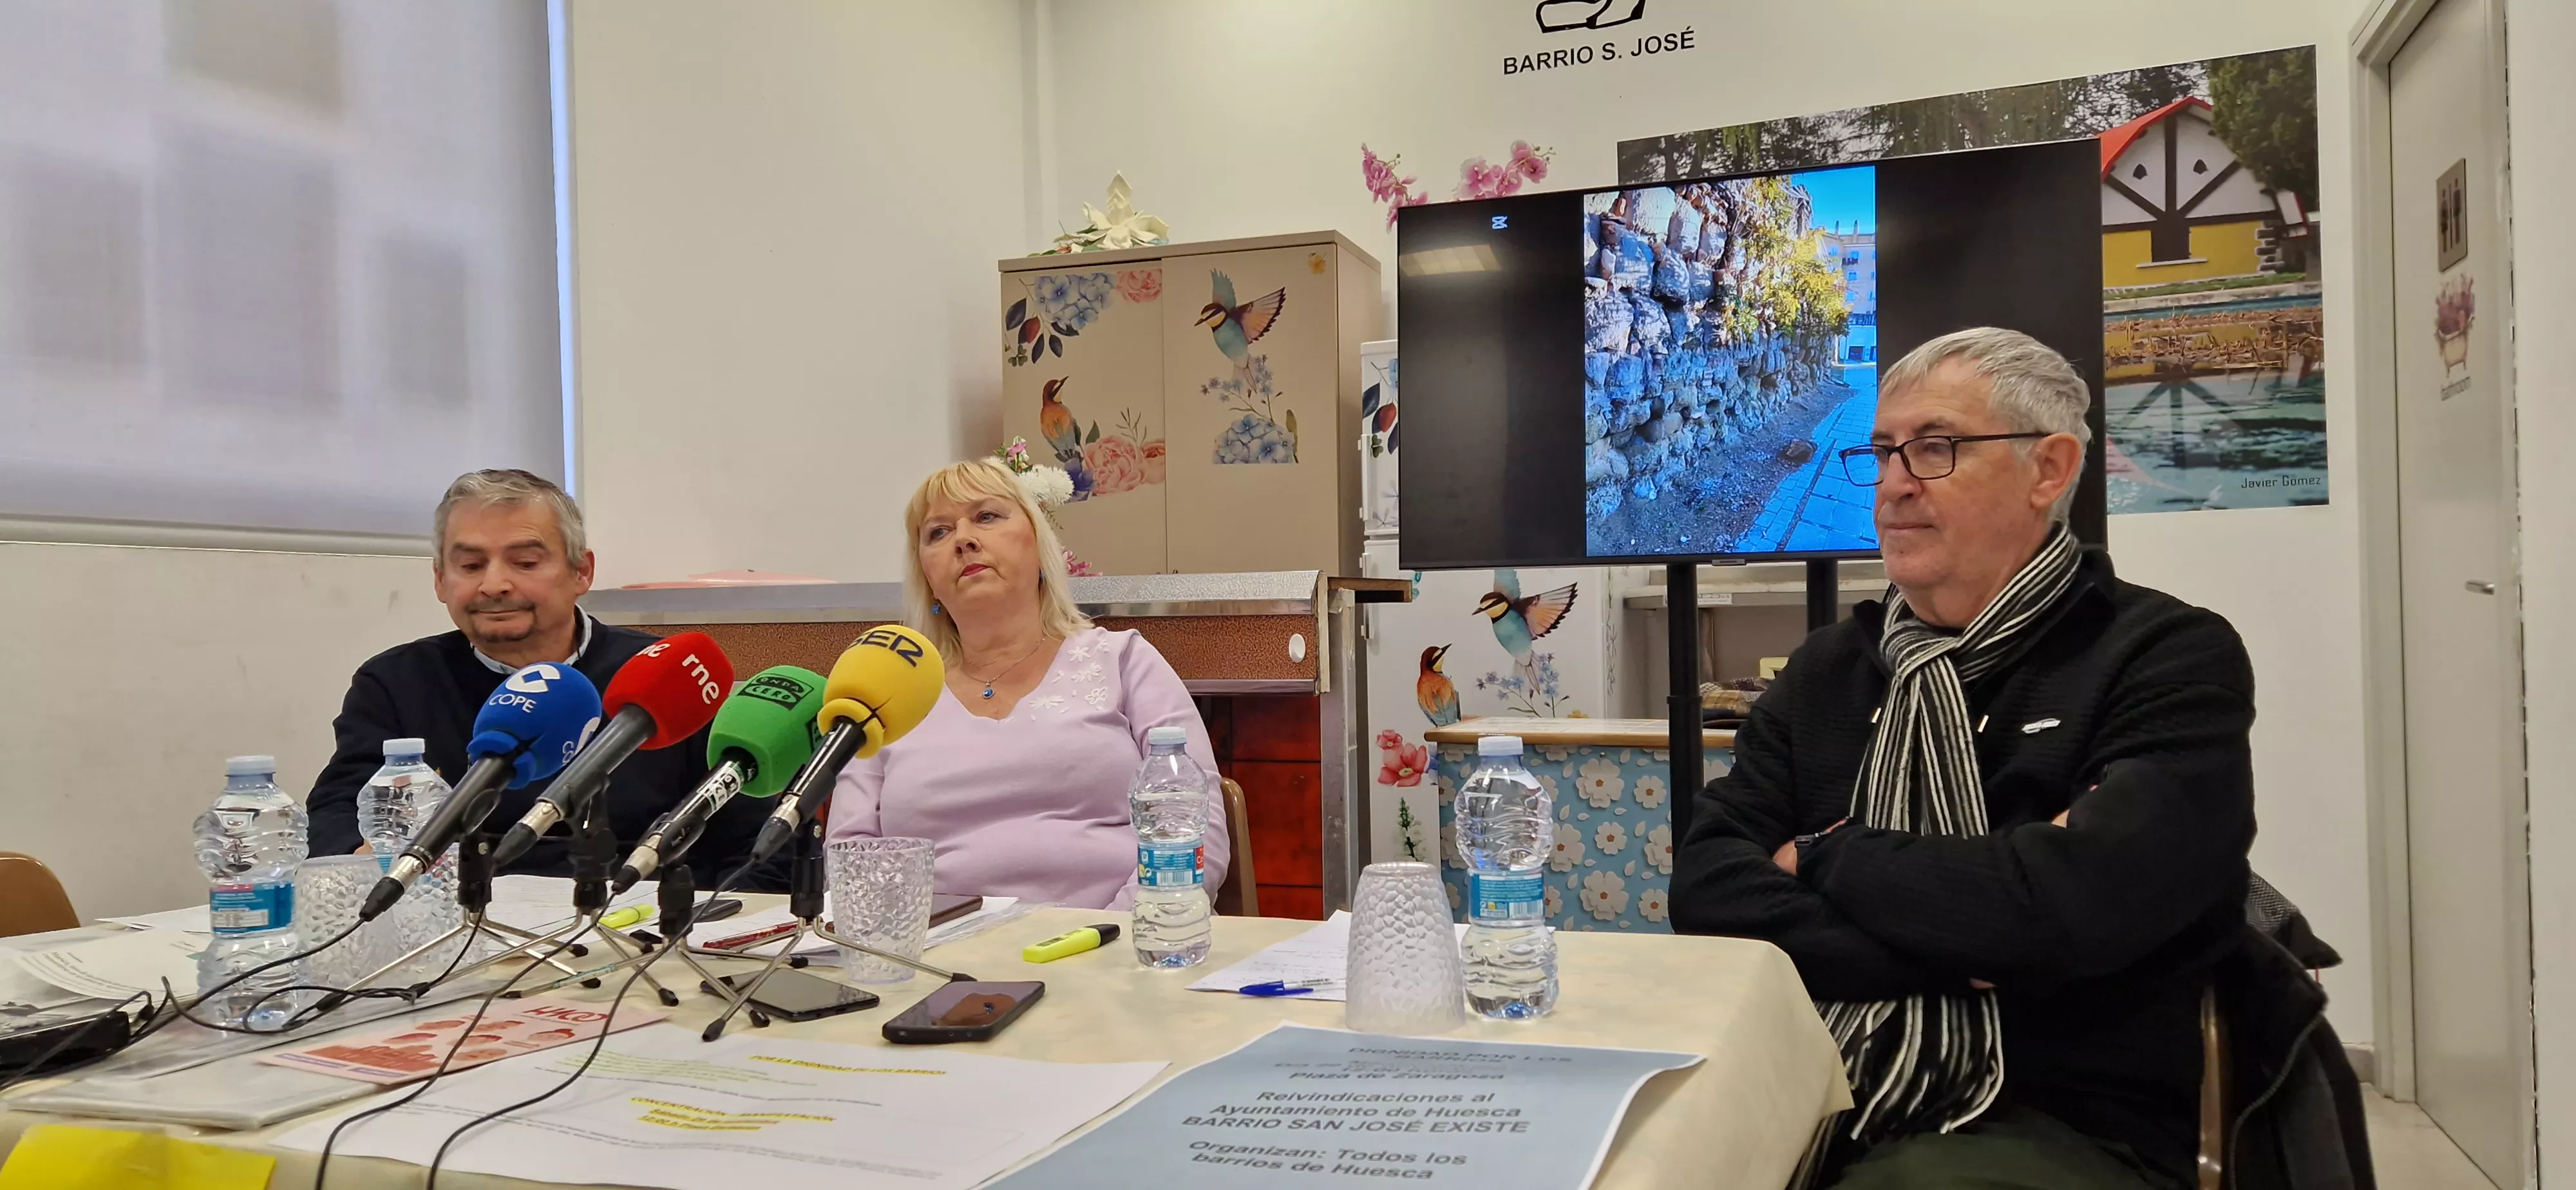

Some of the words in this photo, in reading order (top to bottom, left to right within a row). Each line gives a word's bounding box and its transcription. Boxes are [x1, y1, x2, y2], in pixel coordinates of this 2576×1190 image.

[1503, 46, 1594, 75] BARRIO
[1601, 42, 1623, 61] S.
[1630, 26, 1695, 57] JOSÉ
[2241, 477, 2278, 488] Javier
[682, 654, 719, 704] rne
[761, 677, 799, 691] ONDA
[752, 686, 791, 700] CERO
[489, 694, 537, 713] COPE
[1391, 1072, 1504, 1081] Zaragoza
[1256, 1091, 1463, 1103] Reivindicaciones
[1470, 1093, 1495, 1102] al
[1209, 1104, 1379, 1117] Ayuntamiento
[1385, 1107, 1417, 1117] de
[1424, 1107, 1522, 1118] Huesca
[1181, 1116, 1282, 1129] BARRIO
[1287, 1119, 1344, 1131] SAN
[1349, 1119, 1425, 1133] JOSÉ
[1428, 1121, 1531, 1133] EXISTE
[1189, 1140, 1327, 1159] Organizan:
[1337, 1148, 1418, 1163] Todos
[1424, 1151, 1468, 1166] los
[1191, 1153, 1284, 1169] barrios
[1290, 1161, 1325, 1173] de
[1330, 1164, 1434, 1180] Huesca
